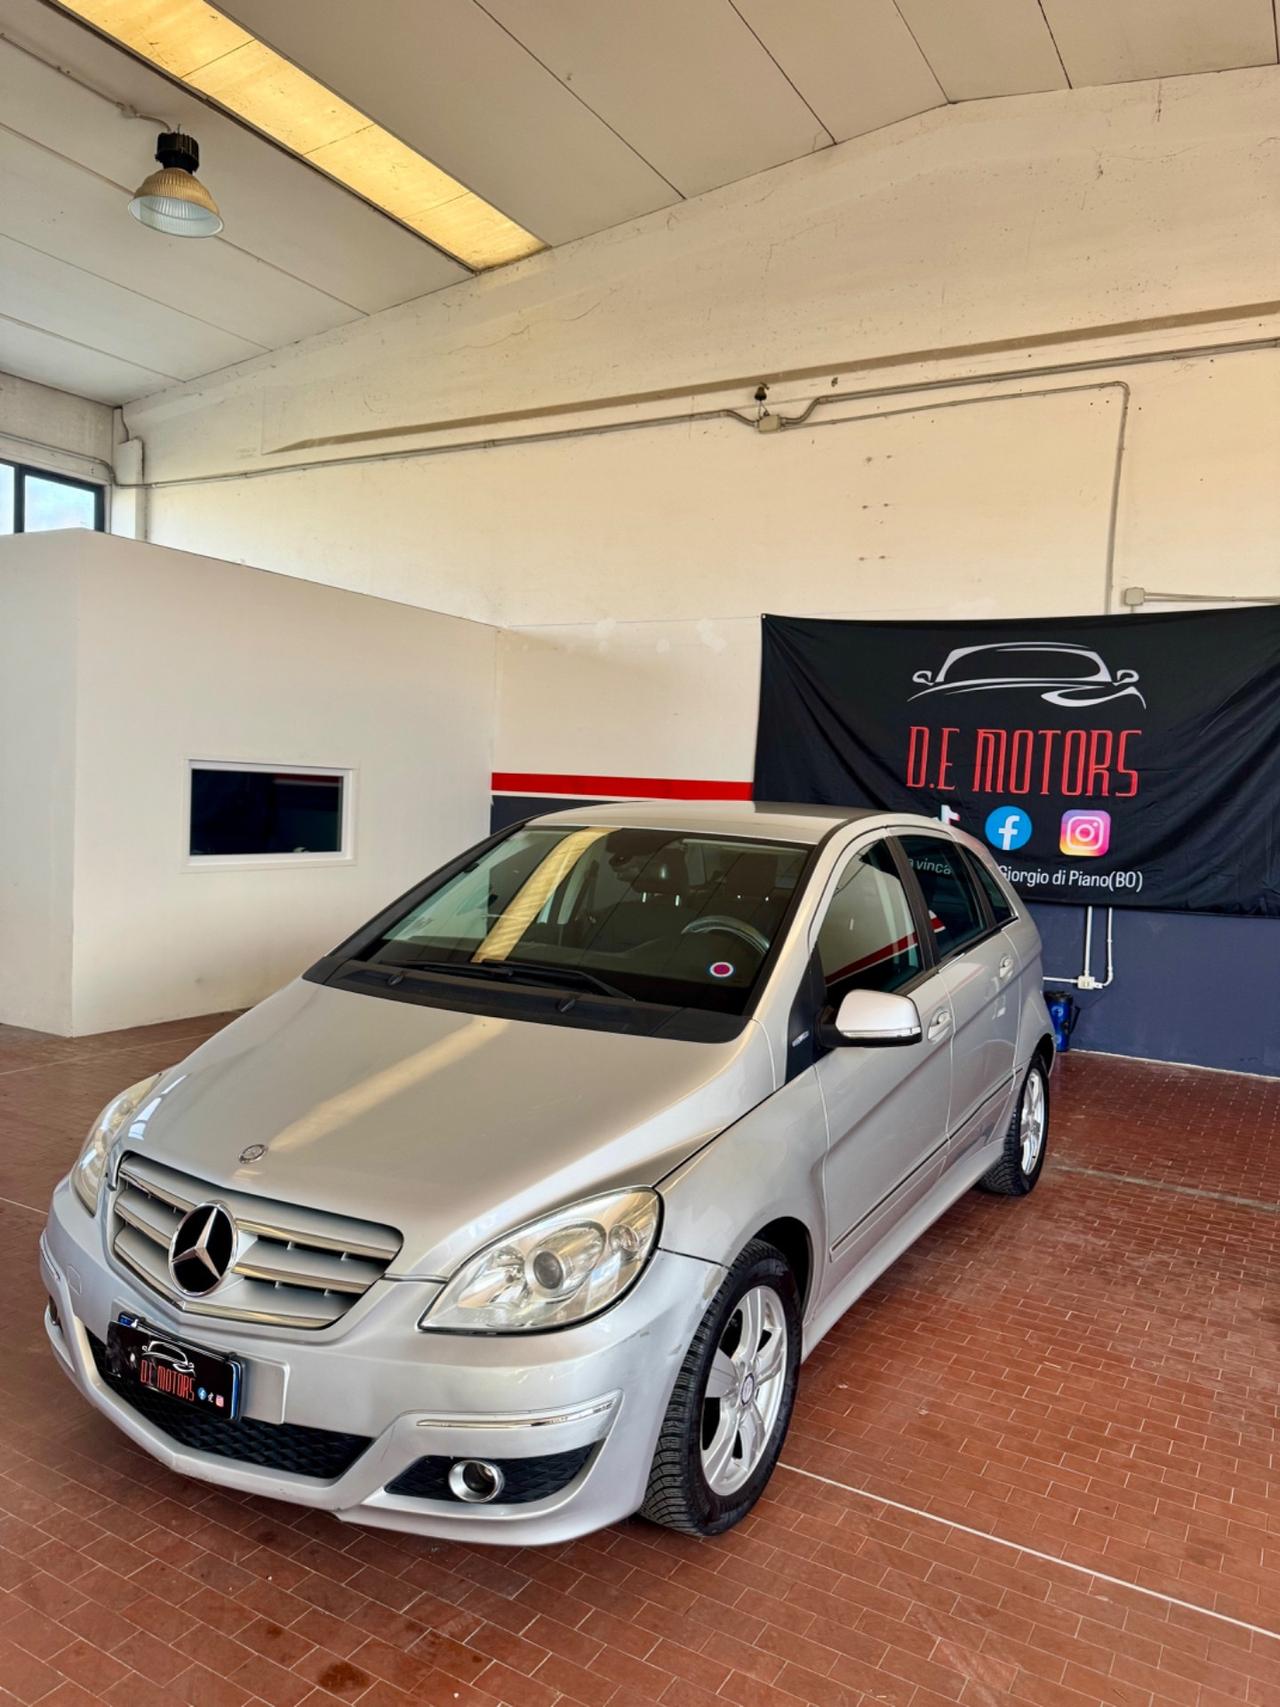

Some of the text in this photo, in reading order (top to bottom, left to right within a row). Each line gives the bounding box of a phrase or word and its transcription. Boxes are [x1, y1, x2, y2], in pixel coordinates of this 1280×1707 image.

[906, 726, 1142, 797] D.E MOTORS
[1052, 869, 1066, 885] di
[1068, 870, 1143, 892] Piano(BO)
[157, 1365, 195, 1402] MOTORS
